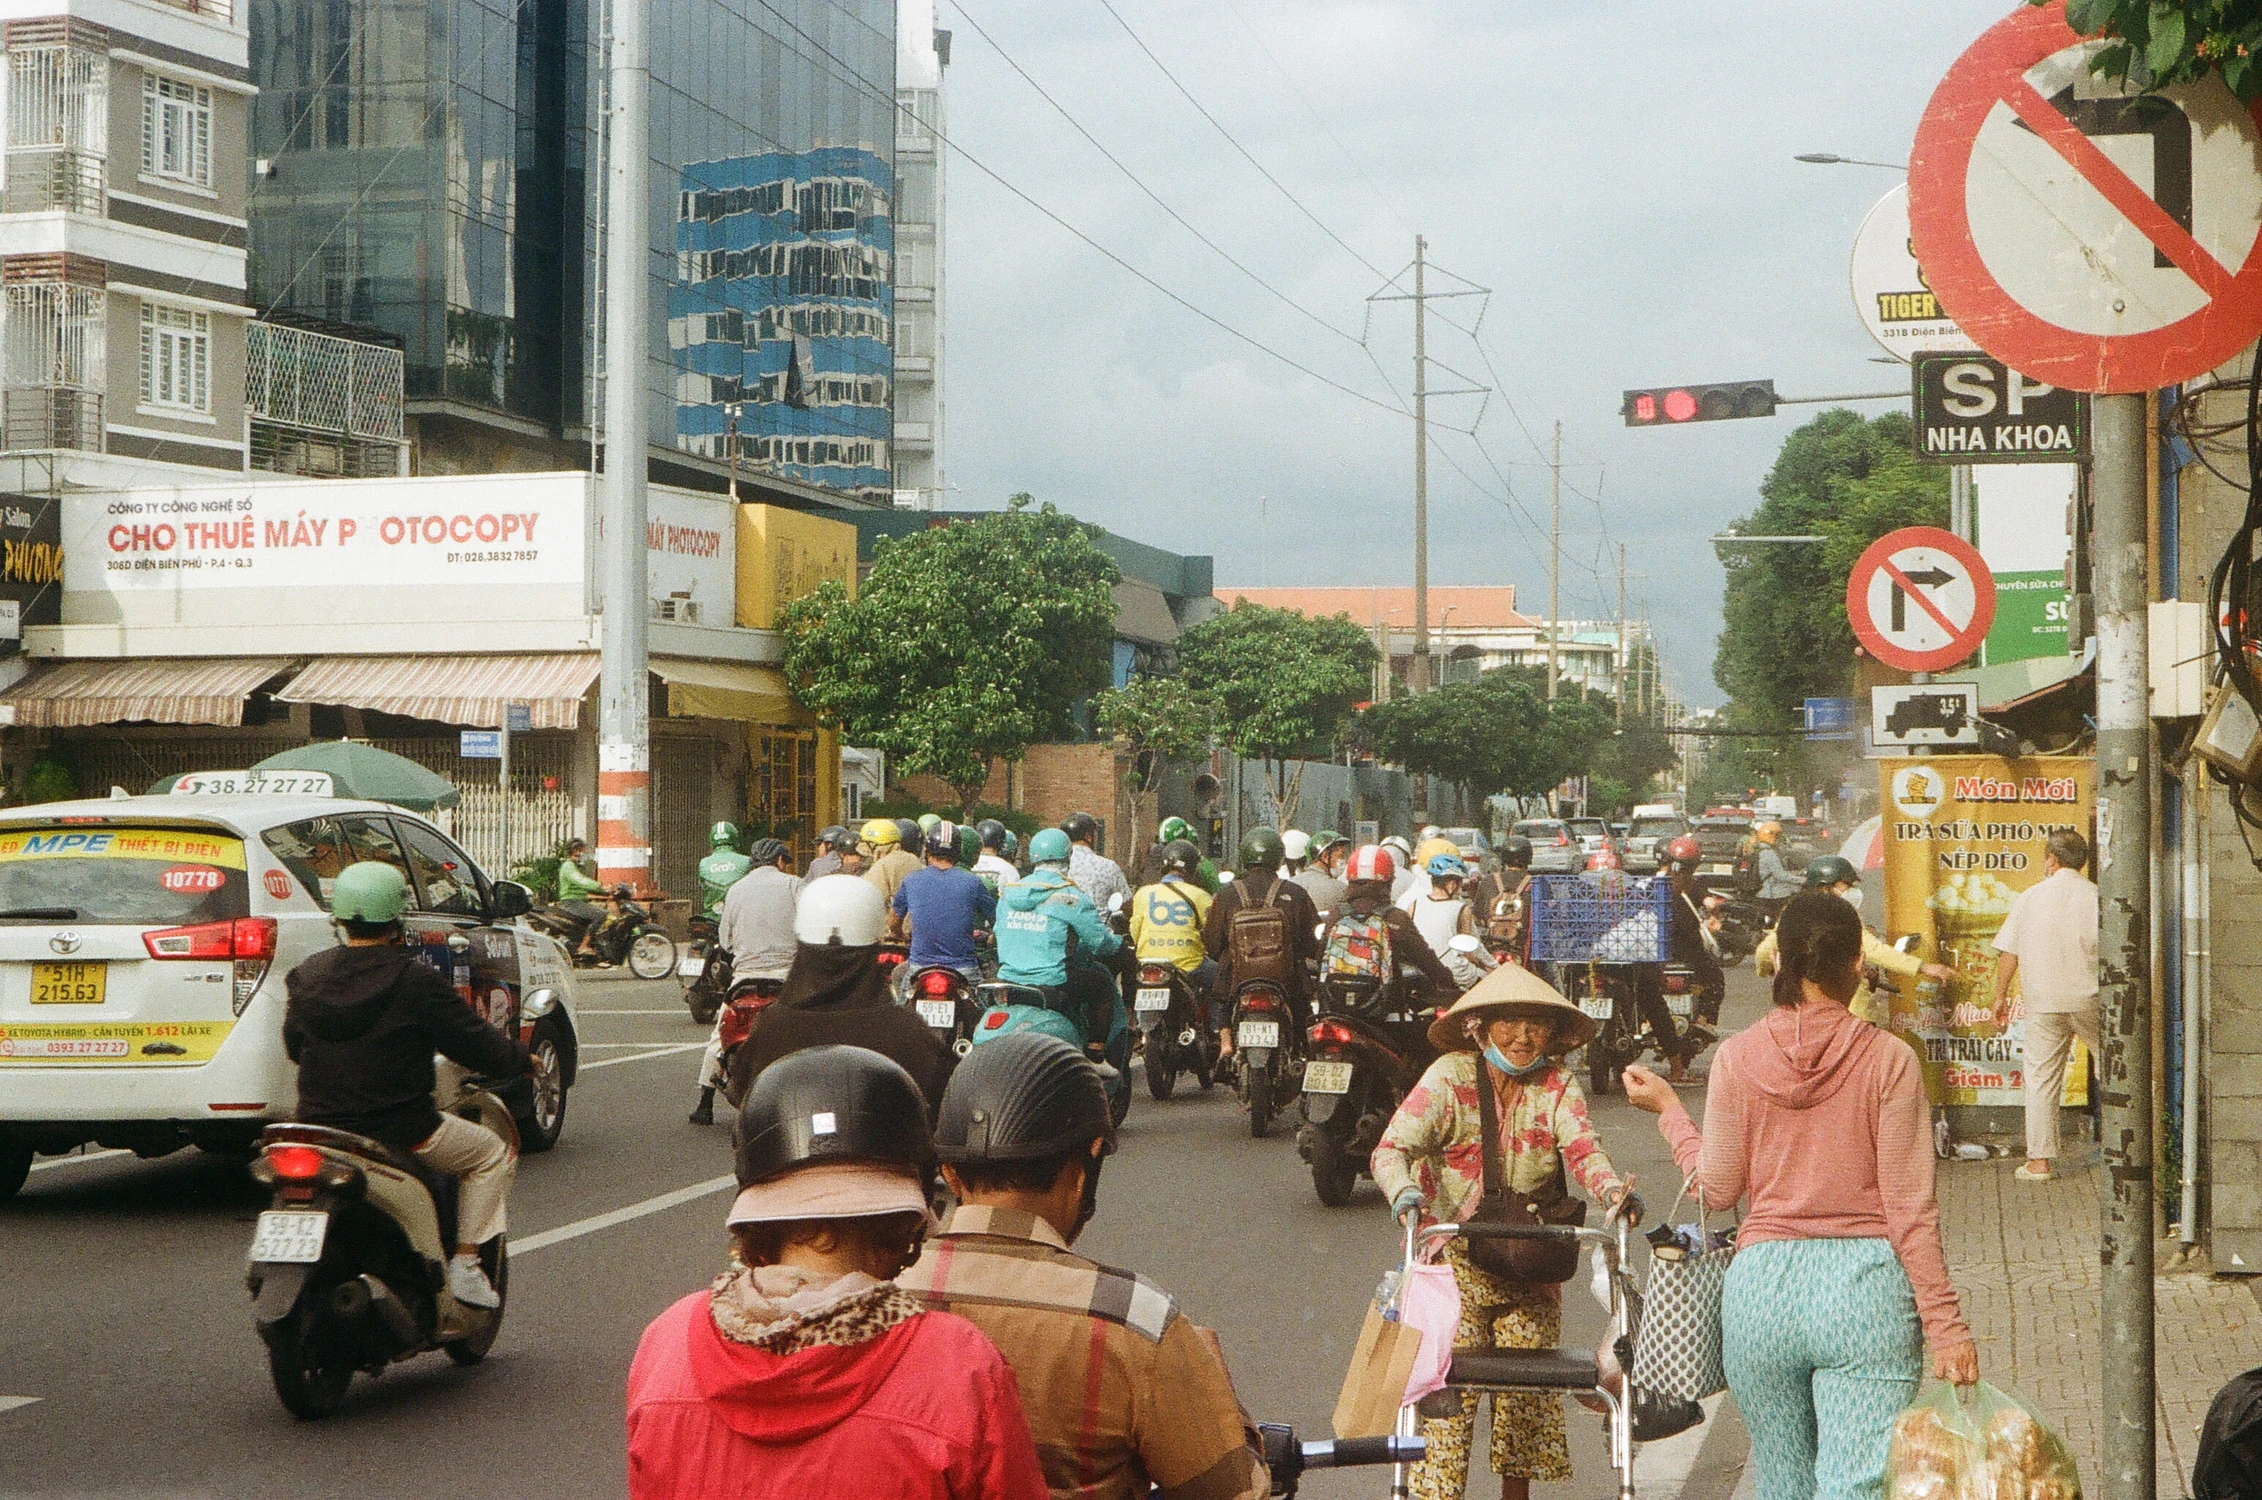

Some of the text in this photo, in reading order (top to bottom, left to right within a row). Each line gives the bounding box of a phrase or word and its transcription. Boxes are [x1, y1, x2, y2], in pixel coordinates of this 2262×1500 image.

[1880, 294, 1936, 319] TIGER
[1883, 328, 1909, 338] 331B
[1928, 425, 2073, 451] NHA KHOA
[107, 501, 143, 514] CÔNG
[146, 502, 158, 513] TY
[161, 499, 198, 513] CÔNG
[108, 523, 177, 552] CHO
[184, 514, 255, 550] THUÊ
[264, 509, 328, 548] MÁY
[667, 524, 720, 558] PHOTOCOPY
[107, 560, 132, 570] 308D
[211, 558, 225, 568] P.4
[235, 558, 253, 568] Q.3
[1994, 579, 2028, 590] HUYÊN
[273, 778, 297, 793] 27
[303, 777, 327, 793] 27
[1955, 776, 2075, 799] Món Mới
[1895, 820, 1935, 841] TRÀ
[1938, 820, 1982, 841] SỮA
[1986, 820, 2033, 841] PHÔ
[22, 833, 114, 854] MPE
[118, 833, 160, 852] THIẾT
[163, 841, 181, 856] BỊ
[1939, 847, 1980, 869] NẾP
[709, 861, 737, 874] Grab
[164, 871, 218, 889] 10778
[1007, 910, 1036, 921] XANH
[1149, 891, 1193, 926] be
[52, 965, 85, 982] 51H
[38, 984, 97, 1001] 215.63
[19, 1028, 52, 1037] TOYOTA
[54, 1027, 87, 1037] HYBRID
[199, 1026, 212, 1036] XE
[95, 1042, 108, 1053] 27
[112, 1042, 125, 1052] 27
[1944, 1067, 2004, 1087] Giảm
